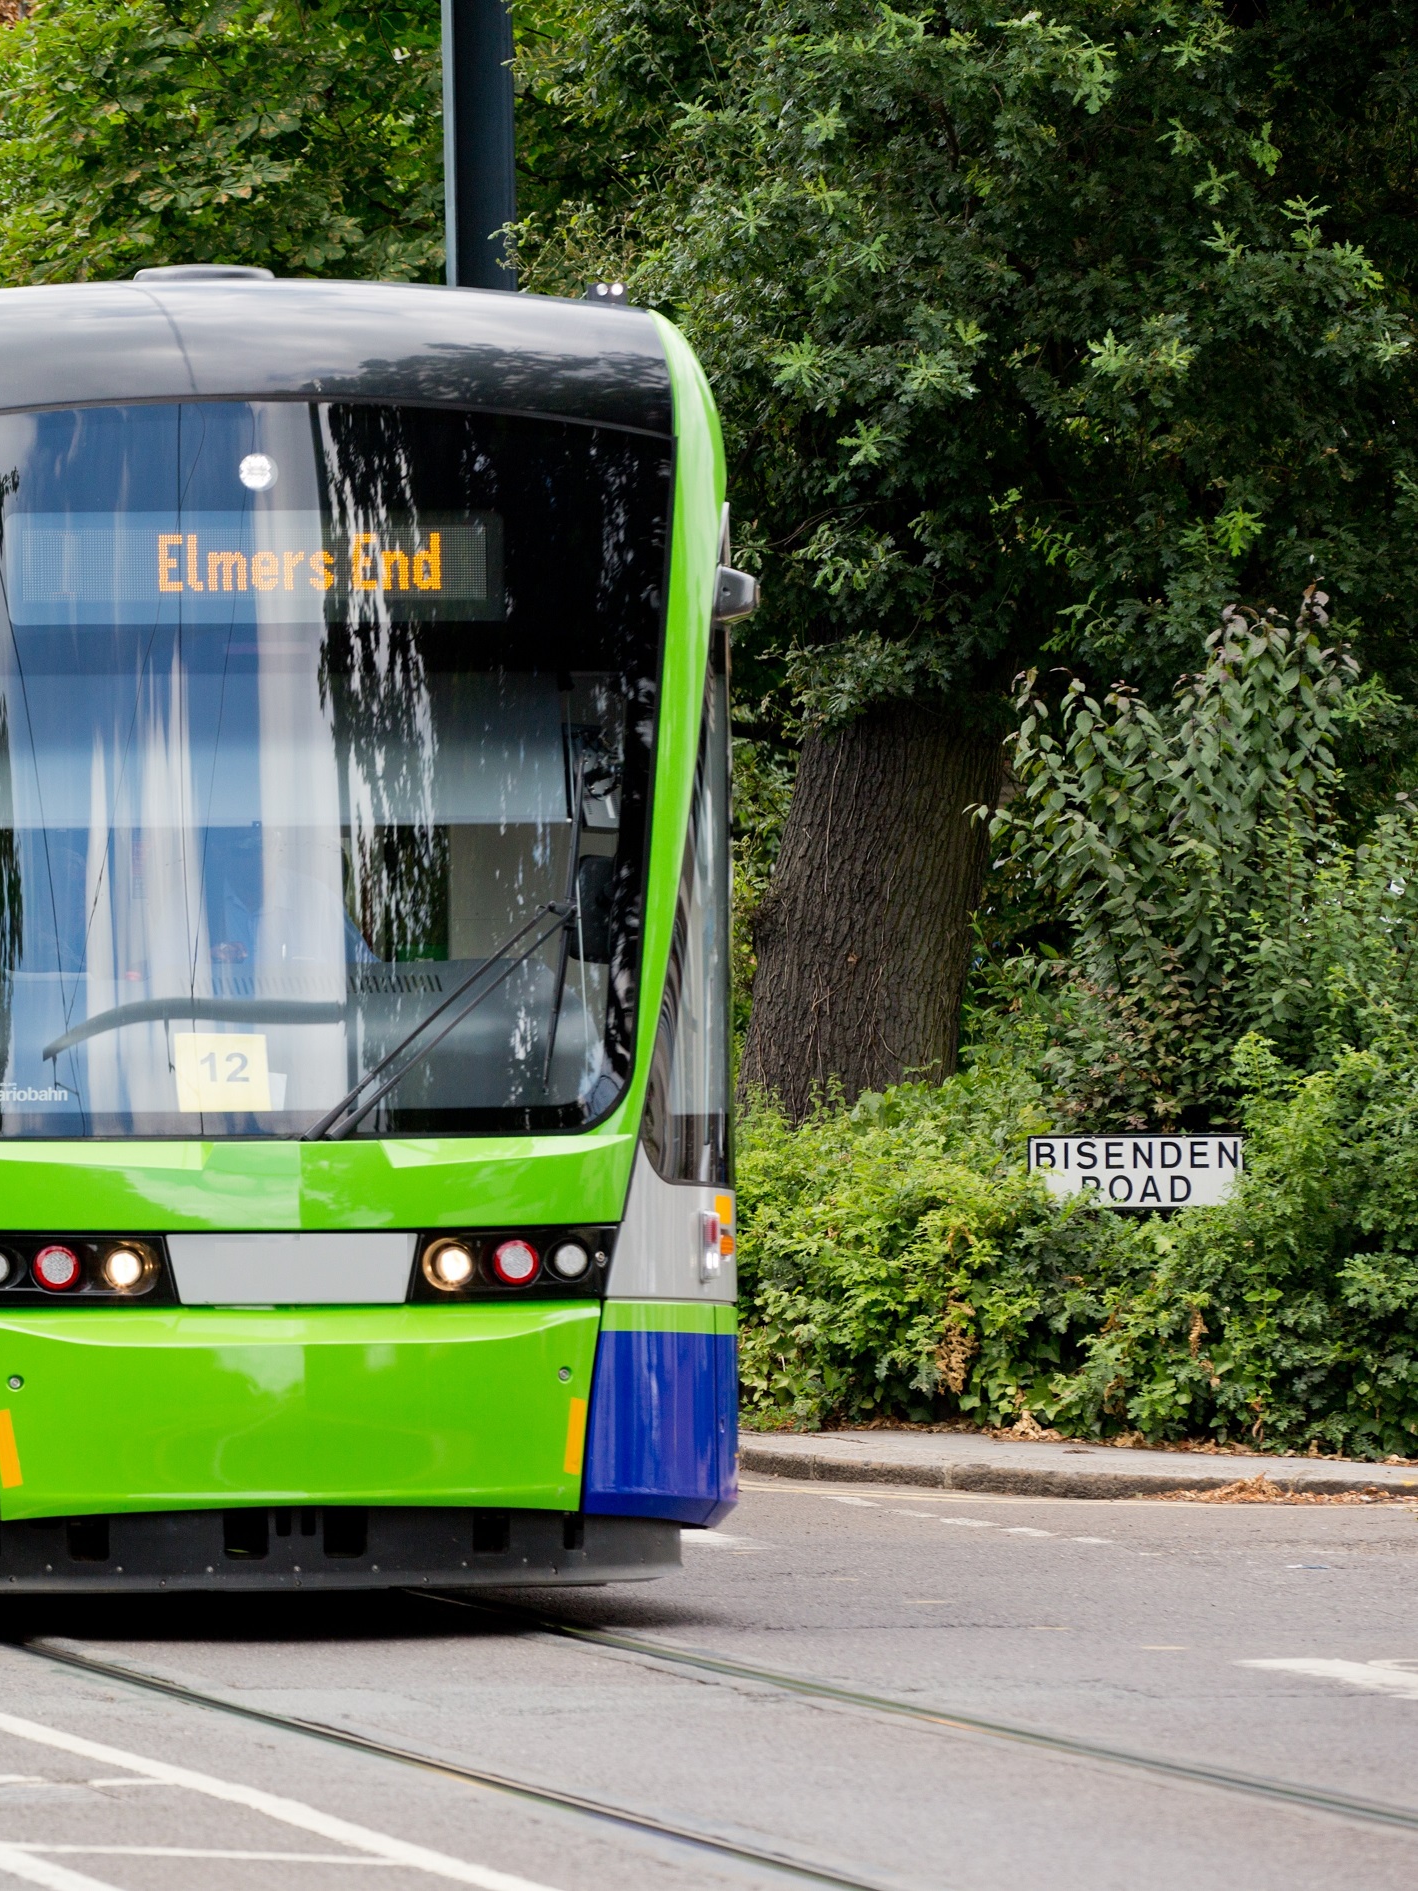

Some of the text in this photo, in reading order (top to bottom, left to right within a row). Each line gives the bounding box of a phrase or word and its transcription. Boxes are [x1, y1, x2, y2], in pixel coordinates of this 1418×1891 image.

[157, 532, 442, 592] Elmers End
[200, 1052, 250, 1082] 12
[1035, 1141, 1238, 1170] BISENDEN
